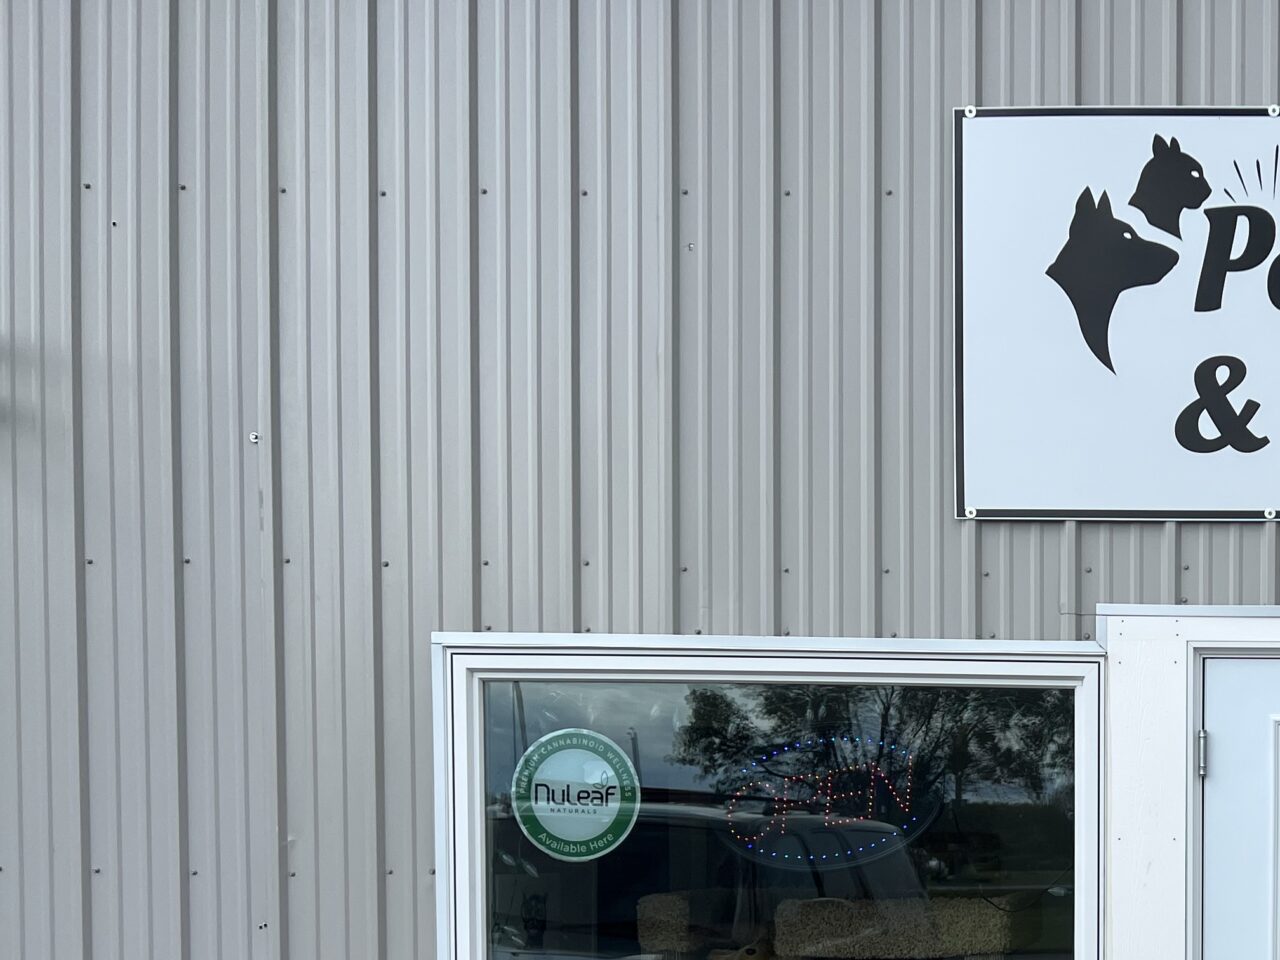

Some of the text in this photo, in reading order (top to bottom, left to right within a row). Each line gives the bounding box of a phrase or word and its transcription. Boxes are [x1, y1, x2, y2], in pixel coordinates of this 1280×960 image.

[1174, 355, 1271, 453] &
[519, 737, 632, 797] PREMIUM CANNABINOID WELLNESS
[728, 755, 912, 841] OPEN
[538, 831, 614, 853] Available Here
